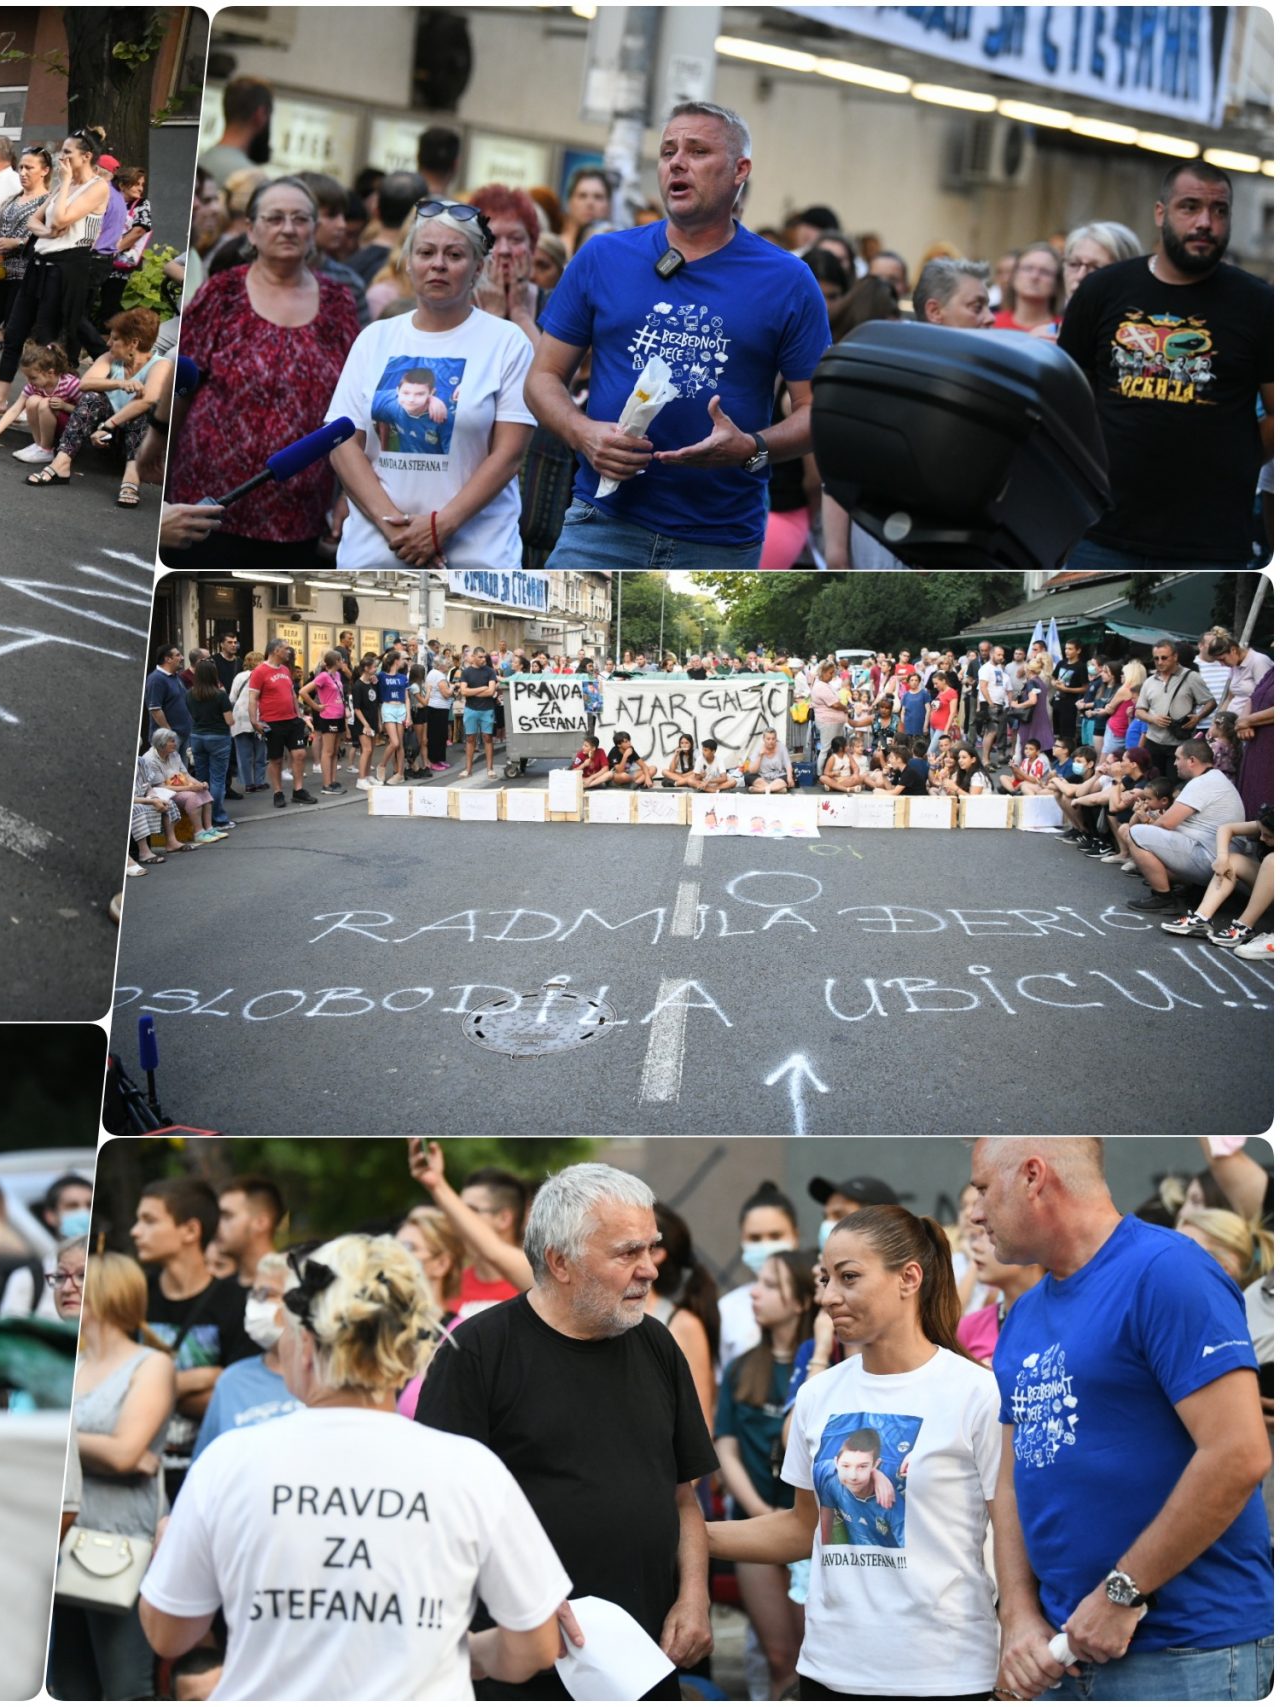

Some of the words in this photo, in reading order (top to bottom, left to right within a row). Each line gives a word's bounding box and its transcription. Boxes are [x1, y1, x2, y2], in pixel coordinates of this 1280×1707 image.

[408, 459, 442, 472] STEFANA
[514, 681, 583, 701] PRAVDA
[537, 701, 562, 717] ZA
[596, 693, 694, 729] LAZAR
[518, 715, 589, 732] STEFANA
[613, 711, 770, 762] UBICA
[271, 1484, 430, 1523] PRAVDA
[322, 1536, 372, 1570] ZA
[860, 1553, 896, 1569] STEFANA
[897, 1556, 908, 1569] !!!
[249, 1588, 404, 1626] STEFANA
[416, 1596, 443, 1629] !!!
